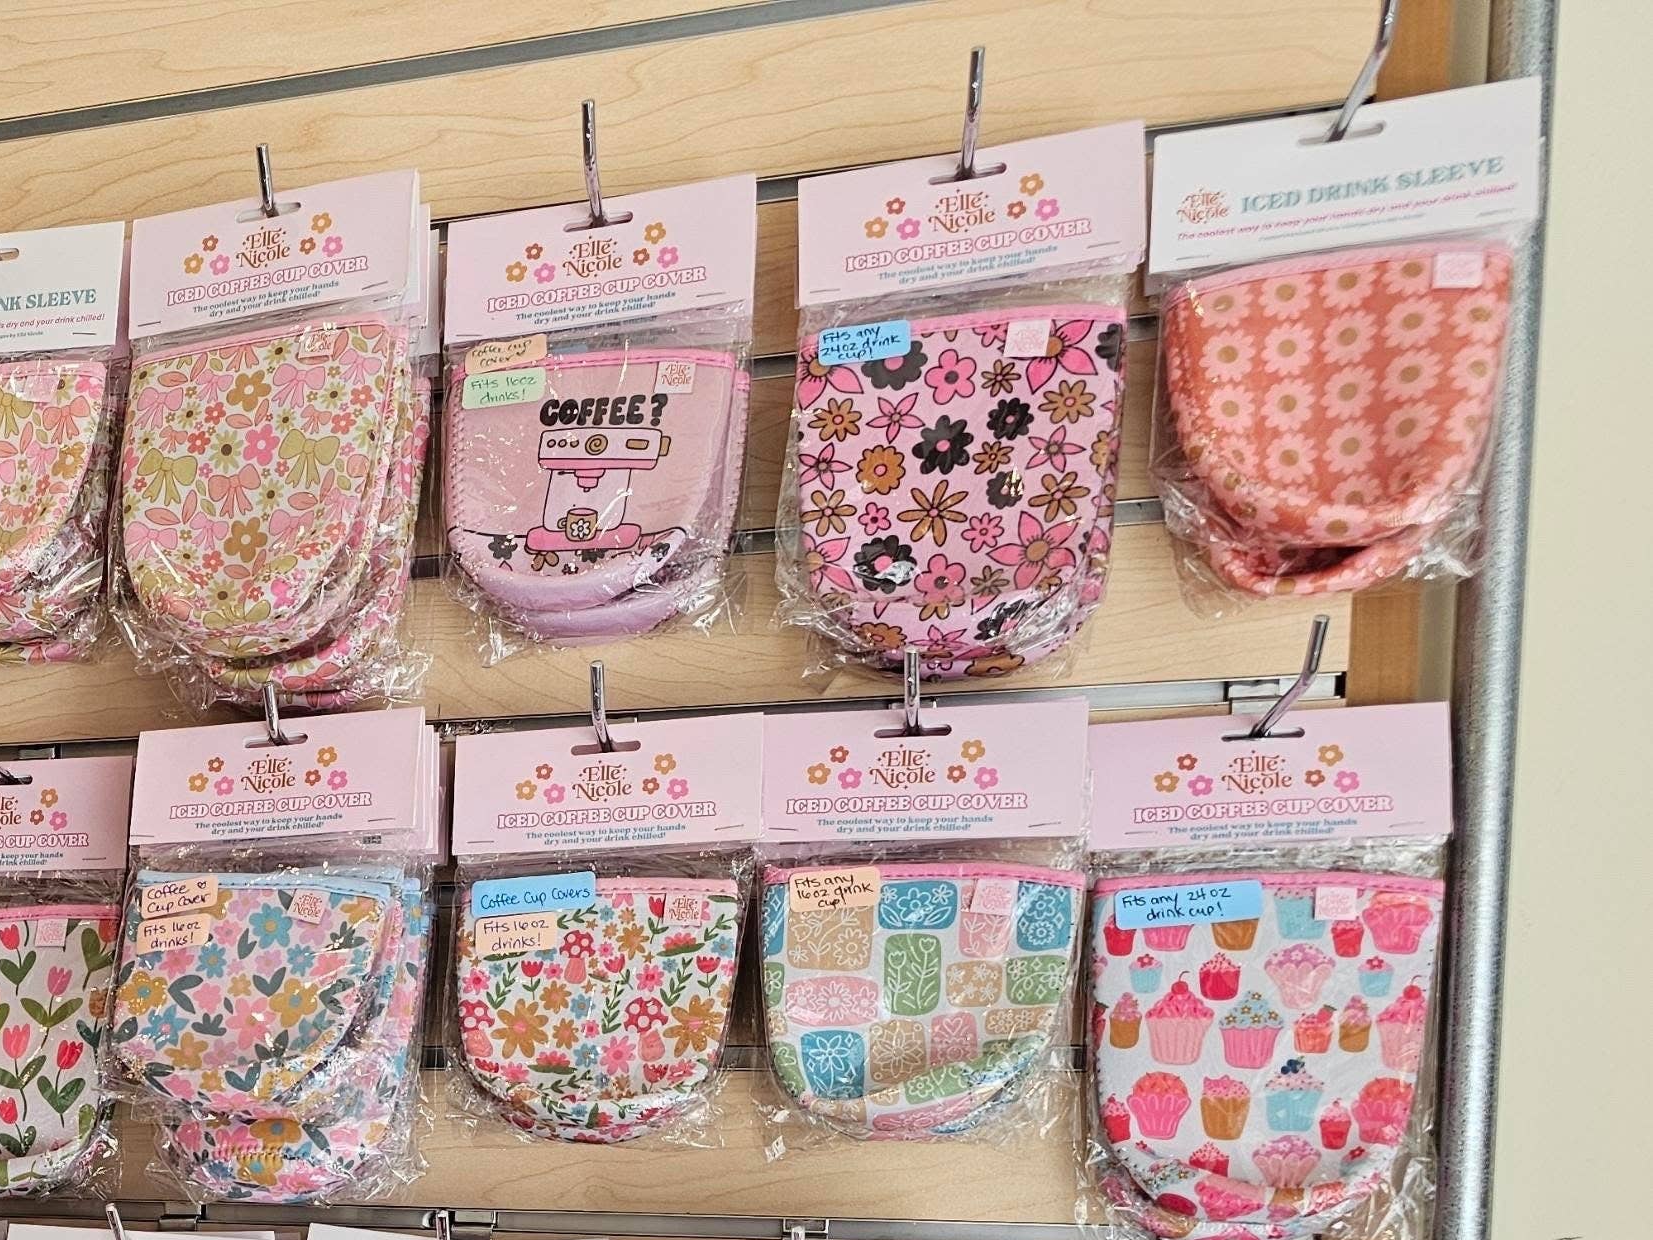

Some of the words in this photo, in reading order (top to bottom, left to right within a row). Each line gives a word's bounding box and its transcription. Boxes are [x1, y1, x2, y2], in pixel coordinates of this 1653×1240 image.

[1241, 189, 1300, 213] ICED
[1307, 175, 1390, 204] DRINK
[1394, 156, 1504, 189] SLEEVE
[246, 228, 282, 249] Elle
[846, 252, 891, 272] ICED
[894, 239, 972, 265] COFFEE
[975, 231, 1016, 251] CUP
[1017, 218, 1091, 243] COVER
[236, 244, 291, 269] Nicole
[167, 285, 206, 306] ICED
[207, 273, 270, 298] COFFEE
[271, 265, 307, 287] CUP
[307, 256, 369, 278] COVER
[487, 294, 529, 312] ICED
[531, 283, 601, 306] COFFEE
[603, 275, 640, 295] CUP
[641, 265, 706, 289] COVER
[25, 289, 96, 308] SLEEVE
[540, 392, 668, 426] COFFEE?
[252, 758, 287, 775] Elle
[241, 774, 296, 794] Nicole
[170, 803, 209, 820] ICED
[210, 799, 274, 816] COFFEE
[276, 796, 312, 812] CUP
[312, 791, 371, 808] COVER
[498, 813, 539, 829] ICED
[541, 809, 611, 827] COFFEE
[613, 806, 650, 822] CUP
[652, 801, 716, 819] COVER
[1134, 807, 1184, 823] ICED
[1187, 802, 1267, 820] COFFEE
[1272, 799, 1315, 816] CUP
[1317, 796, 1393, 812] COVER
[6, 835, 35, 848] CUP
[37, 833, 89, 847] COVER
[1146, 904, 1185, 919] drink
[1188, 901, 1223, 917] cup!
